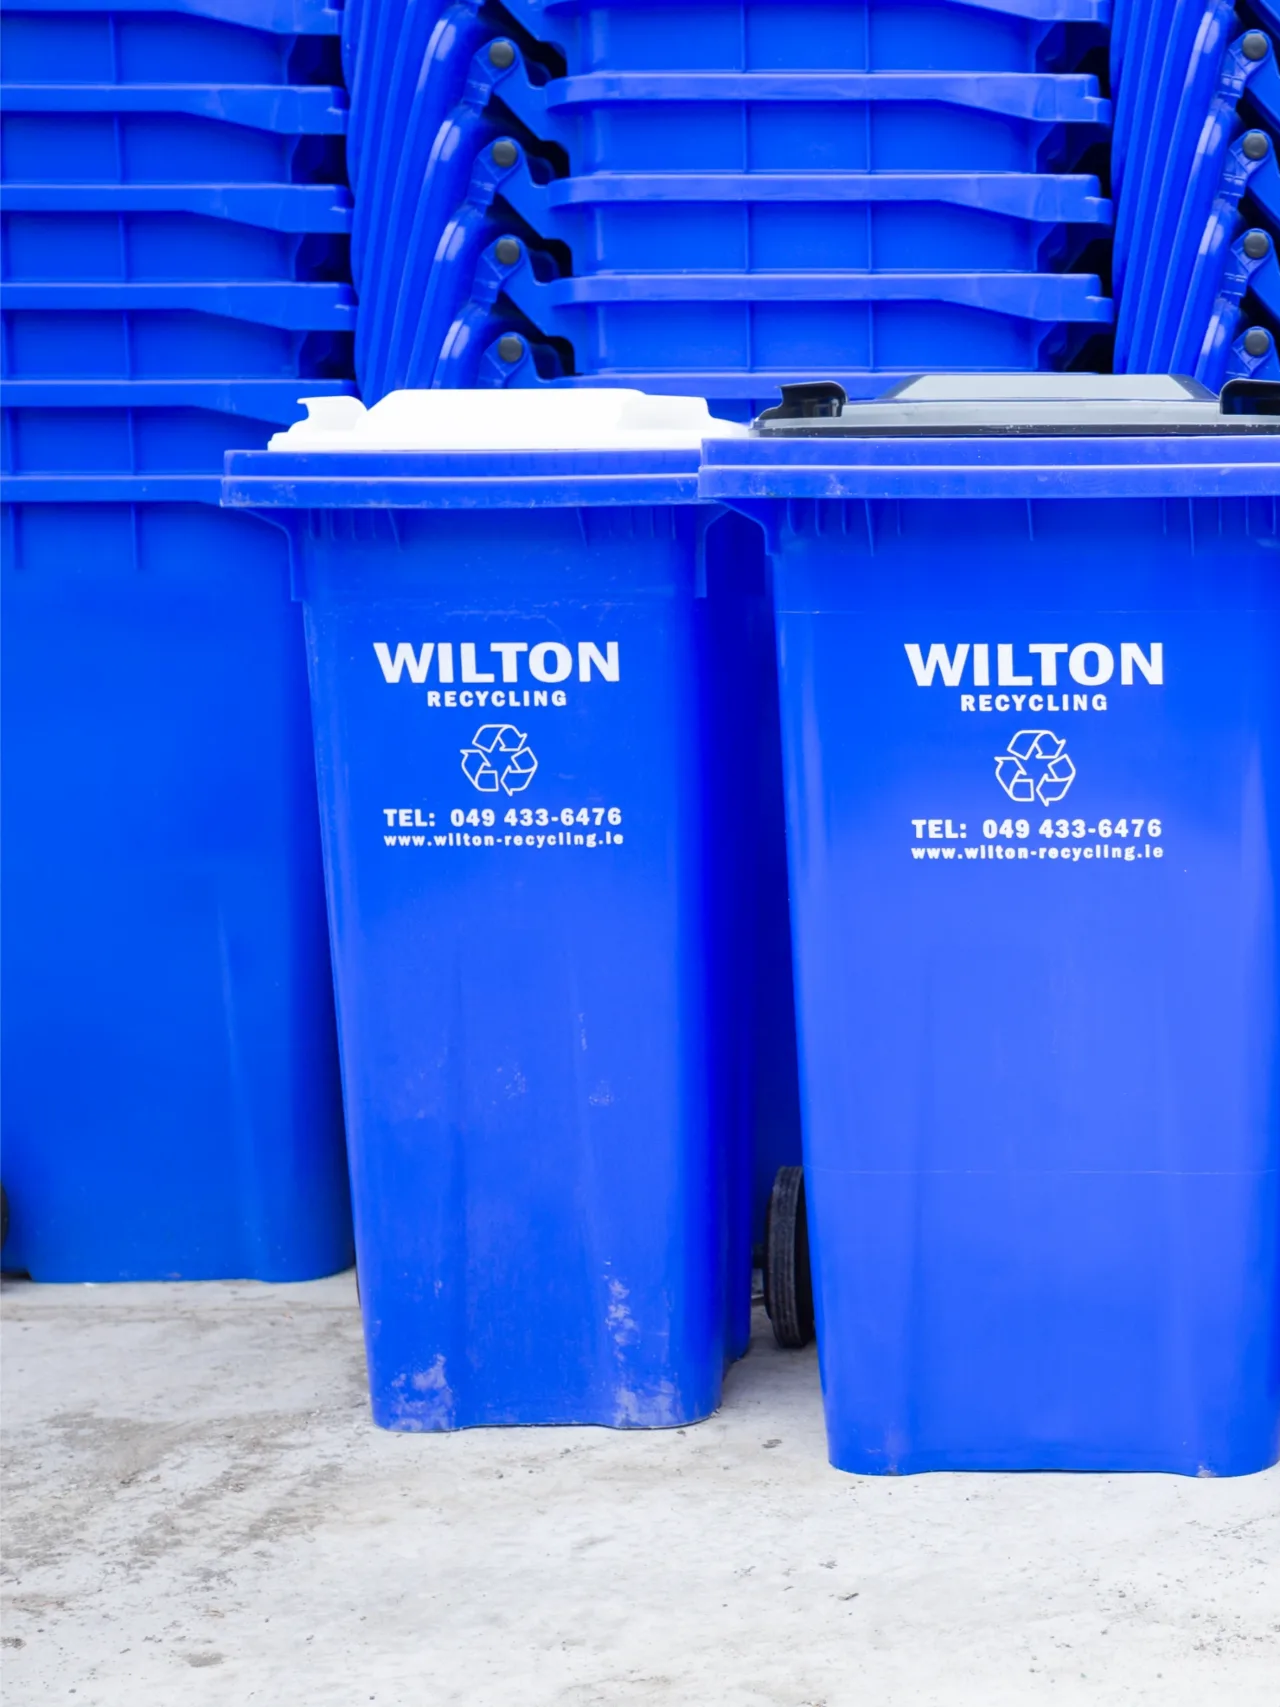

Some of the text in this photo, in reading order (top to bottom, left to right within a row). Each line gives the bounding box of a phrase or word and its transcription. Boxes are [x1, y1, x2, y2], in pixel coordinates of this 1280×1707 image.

[374, 642, 619, 683] WILTON
[905, 643, 1163, 686] WILTON
[428, 691, 566, 706] RECYCLING
[961, 694, 1106, 711] RECYCLING
[384, 808, 621, 826] TEL: 049 433-6476
[912, 819, 1161, 838] TEL: 049 433-6476
[384, 832, 623, 848] www.wilton-recycling.ie
[911, 844, 1163, 861] www.wilton-recycling.ie
